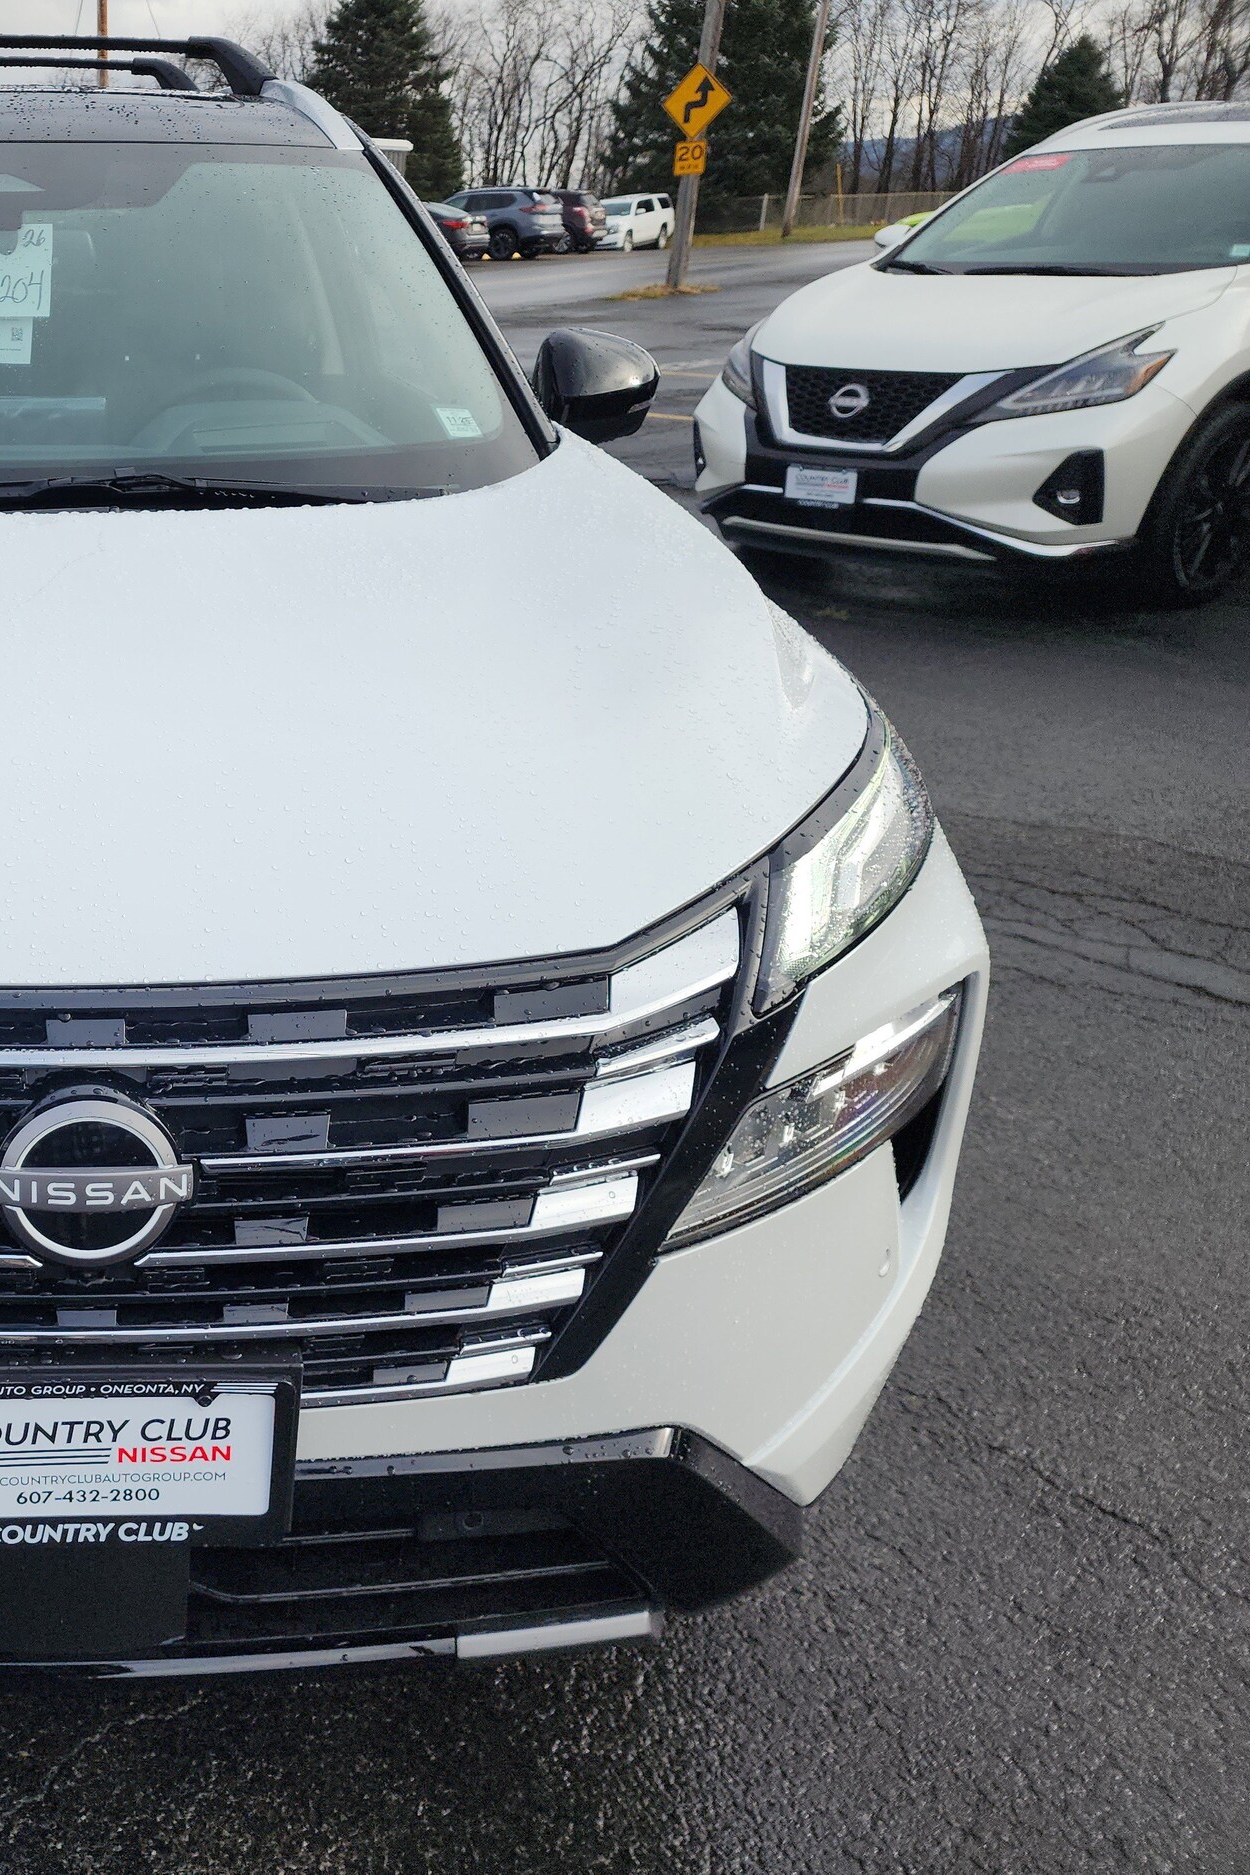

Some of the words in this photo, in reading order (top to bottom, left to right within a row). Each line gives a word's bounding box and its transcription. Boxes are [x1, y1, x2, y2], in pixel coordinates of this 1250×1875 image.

[678, 144, 704, 162] 20
[22, 228, 46, 248] 26
[31, 1384, 86, 1396] GROUP
[140, 1417, 232, 1442] CLUB
[118, 1446, 231, 1463] NISSAN
[16, 1488, 160, 1505] 607-432-2800
[117, 1521, 190, 1544] CLUB
